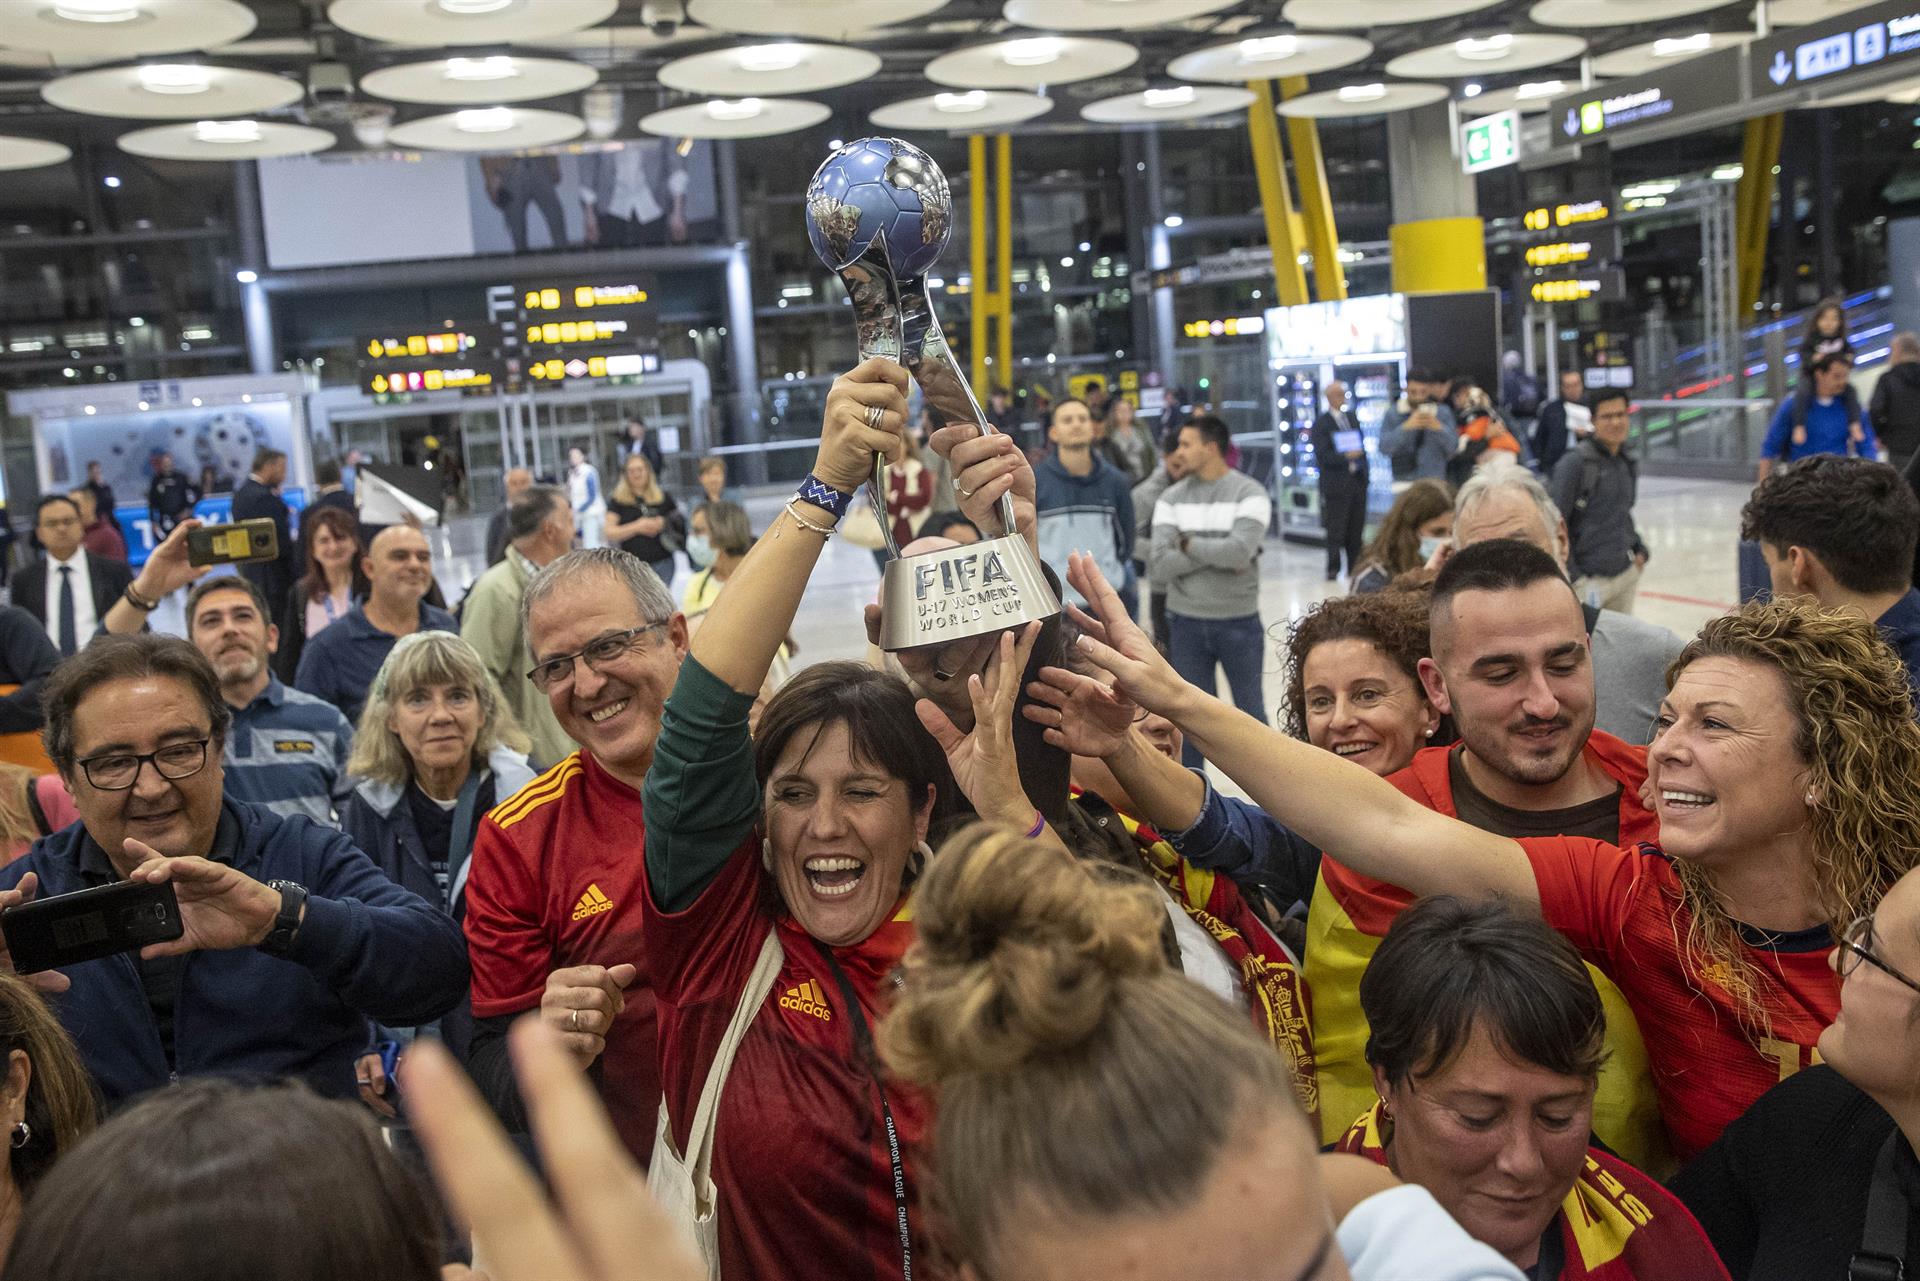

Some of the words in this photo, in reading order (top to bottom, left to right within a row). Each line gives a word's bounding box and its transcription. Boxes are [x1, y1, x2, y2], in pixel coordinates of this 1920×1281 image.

[914, 550, 1012, 600] FIFA
[918, 600, 947, 617] U-17
[952, 584, 1019, 610] WOMEN'S
[920, 608, 982, 632] WORLD
[992, 600, 1023, 616] CUP
[572, 900, 614, 921] adidas
[780, 996, 831, 1021] adidas
[886, 1116, 900, 1163] CHAMPION
[893, 1165, 905, 1199] LEAGUE
[898, 1206, 910, 1248] CHAMPION
[903, 1249, 912, 1281] LEAGUE
